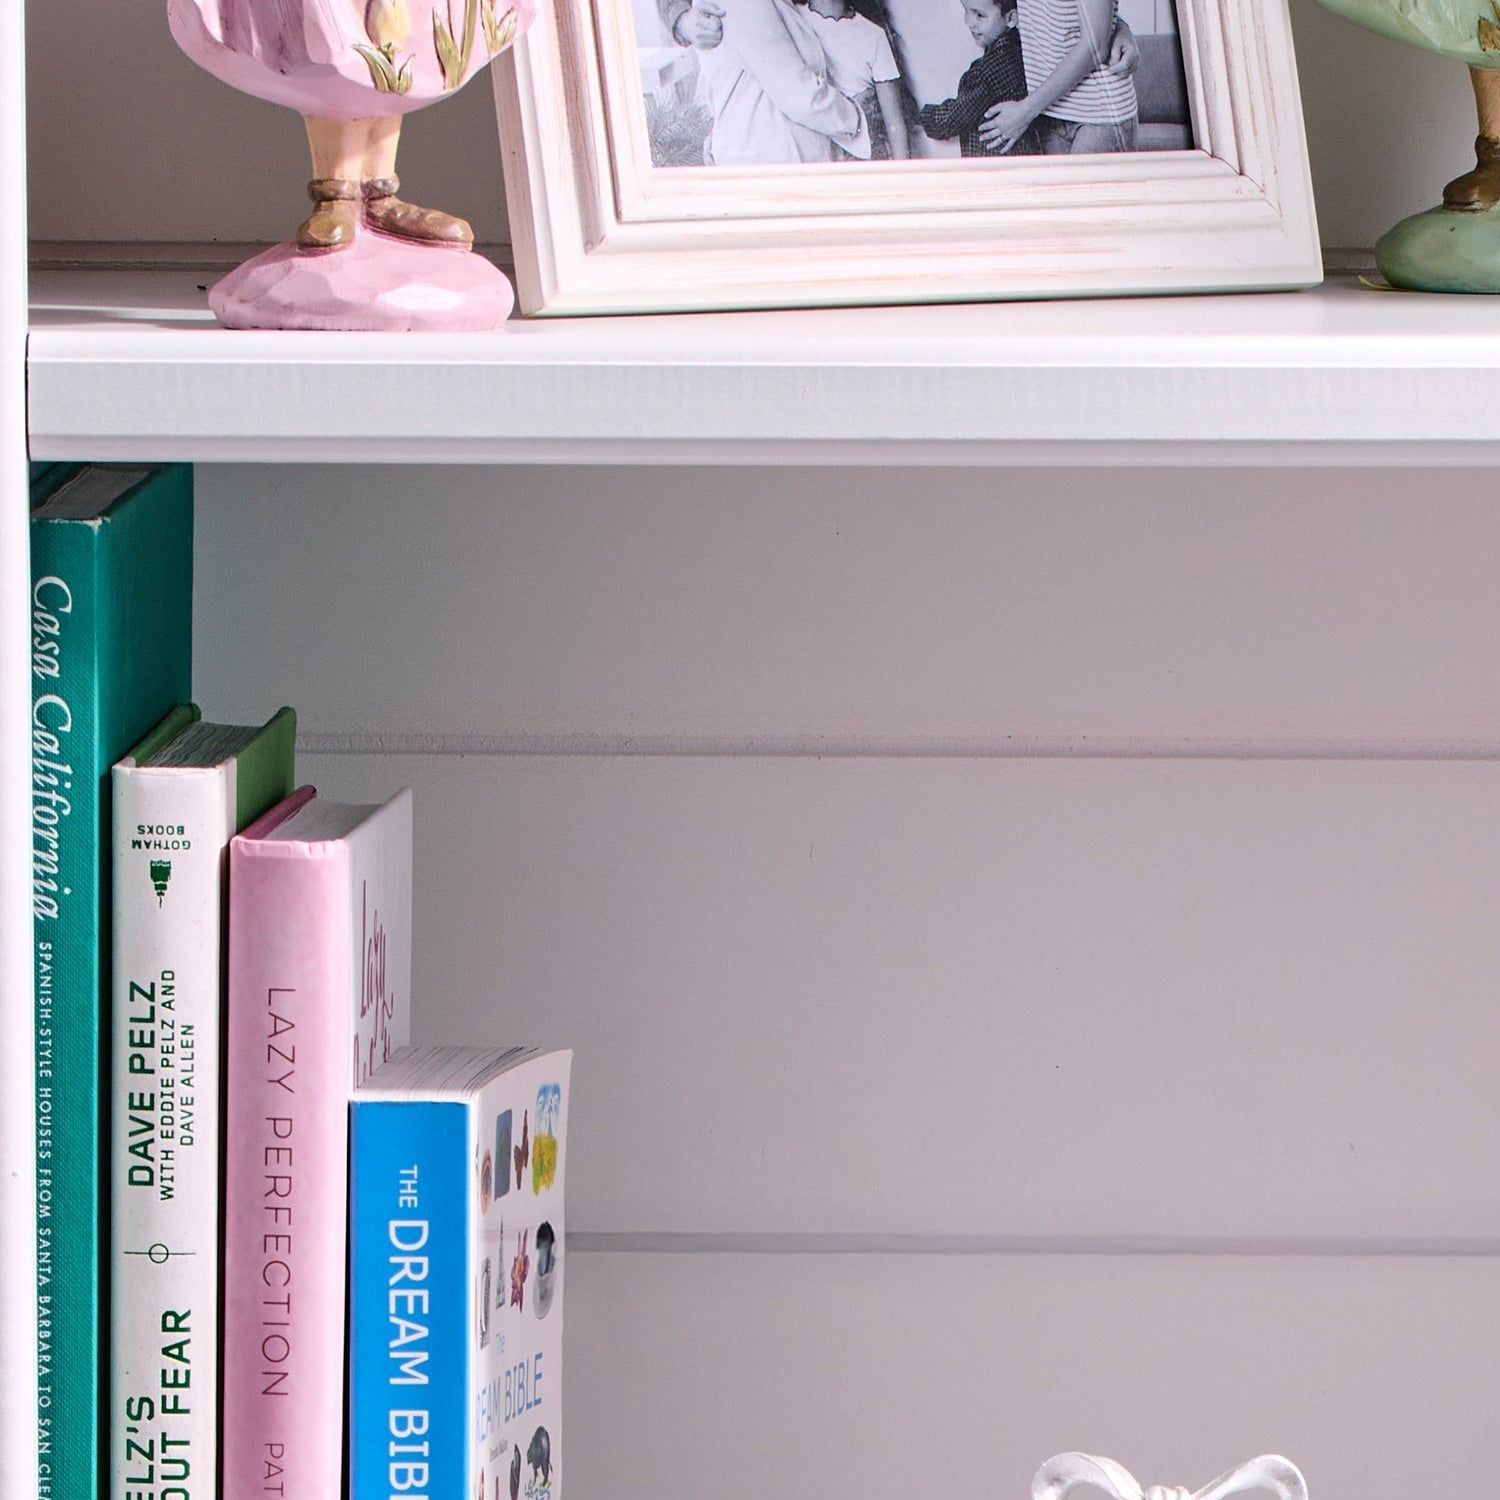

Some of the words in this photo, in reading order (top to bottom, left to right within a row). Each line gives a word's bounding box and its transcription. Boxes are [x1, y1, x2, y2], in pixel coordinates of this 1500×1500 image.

[34, 576, 73, 680] Casa
[33, 694, 73, 920] California
[137, 824, 186, 836] BOOKS
[131, 839, 192, 850] GOTHAM
[38, 942, 52, 1077] SPANISH-STYLE
[161, 969, 175, 1010] AND
[129, 980, 155, 1075] PELZ
[161, 1018, 175, 1068] PELZ
[181, 1023, 195, 1088] ALLEN
[267, 987, 296, 1093] LAZY
[38, 1087, 52, 1159] HOUSES
[128, 1091, 155, 1187] DAVE
[160, 1078, 175, 1140] EDDIE
[180, 1096, 195, 1146] DAVE
[38, 1168, 52, 1218] FROM
[160, 1150, 175, 1201] WITH
[399, 1164, 418, 1208] THE
[38, 1227, 52, 1286] SANTA
[261, 1116, 293, 1397] PERFECTION
[388, 1219, 429, 1385] DREAM
[38, 1295, 52, 1376] BARBARA
[161, 1308, 191, 1415] FEAR
[38, 1385, 52, 1408] TO
[504, 1352, 544, 1424] BIBLE
[38, 1417, 52, 1454] SAN
